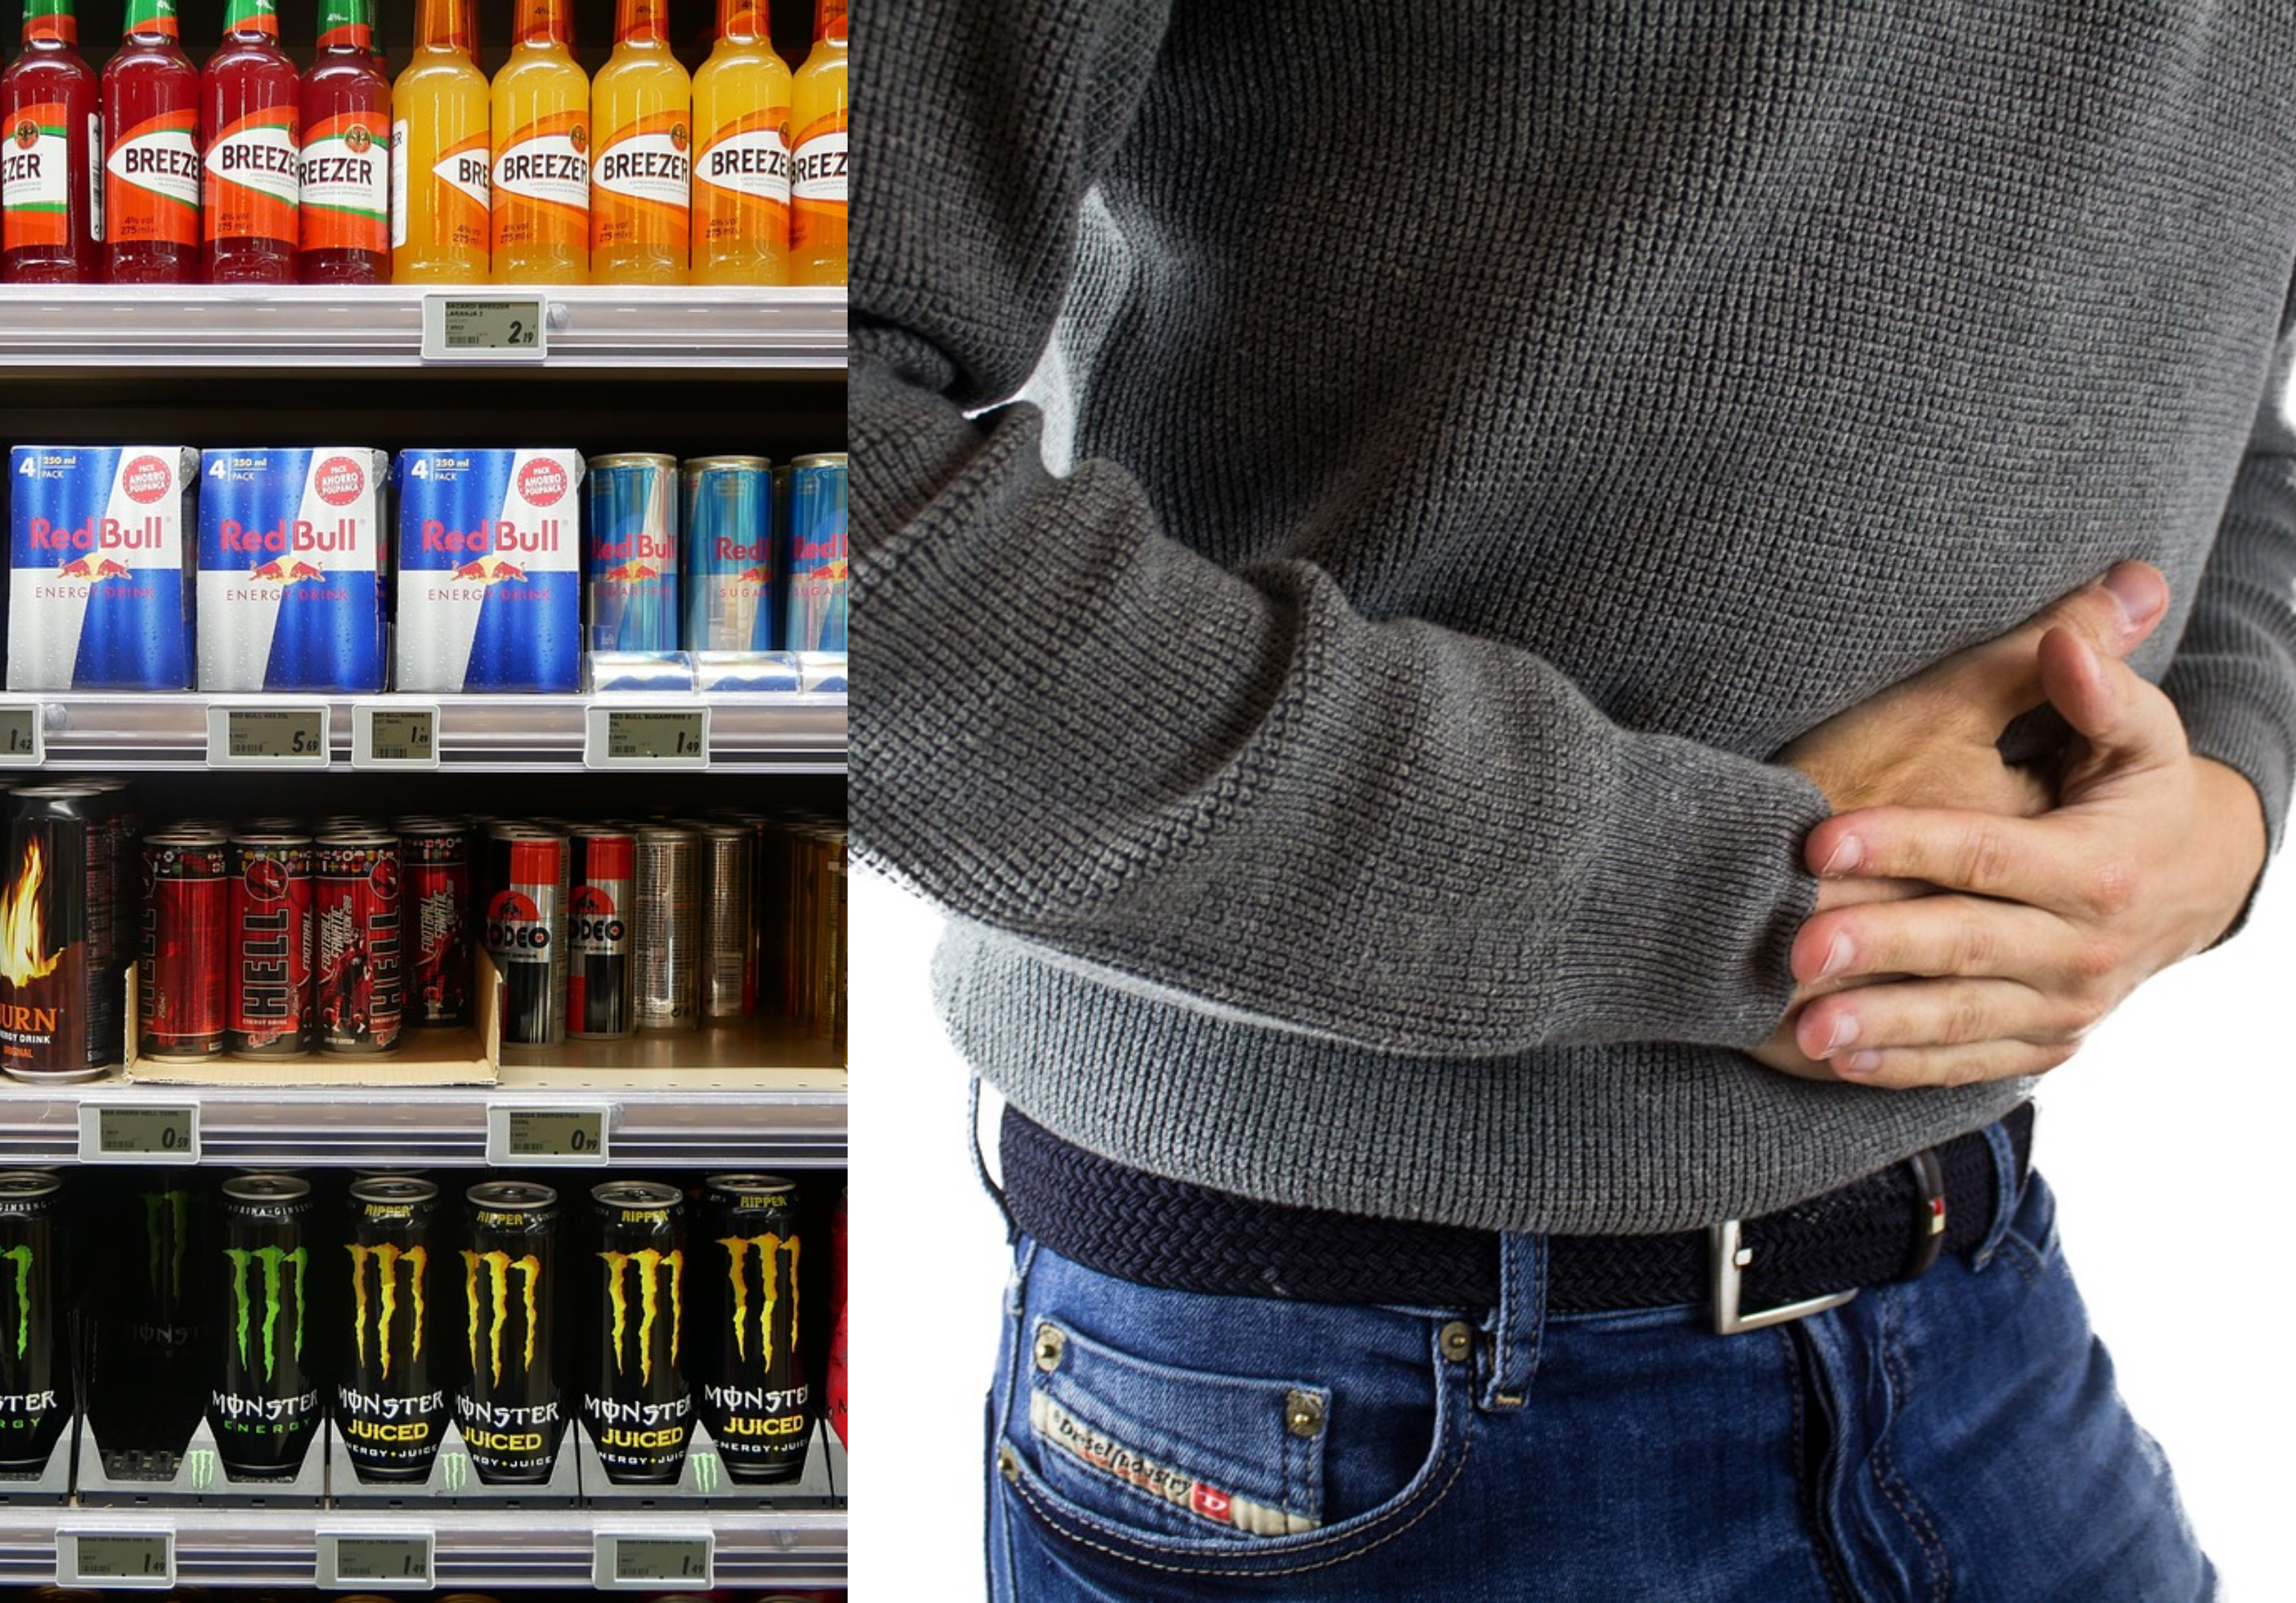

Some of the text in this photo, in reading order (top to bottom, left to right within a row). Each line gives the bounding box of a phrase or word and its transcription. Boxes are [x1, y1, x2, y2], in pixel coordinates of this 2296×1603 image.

[222, 145, 299, 177] BREEZE
[504, 154, 588, 186] BREEZER
[604, 152, 687, 184] BREEZER
[712, 148, 790, 178] BREEZE
[121, 225, 137, 236] 275
[453, 234, 470, 243] 275
[19, 456, 36, 478] 4
[42, 470, 64, 478] PACK
[209, 459, 227, 480] 4
[232, 472, 255, 480] PACK
[411, 459, 428, 480] 4
[434, 473, 457, 481] PACK
[30, 516, 162, 550] Red Bull
[221, 518, 355, 551] Red Bull
[423, 519, 559, 551] Red Bull
[715, 537, 762, 561] Red
[36, 587, 155, 598] ENERGY DRINK
[227, 589, 348, 601] ENERGY DRINK
[428, 589, 551, 601] ENERGY DRINK
[292, 730, 319, 753] 5 69
[687, 741, 700, 753] 49
[243, 908, 288, 1017] HELL
[369, 905, 400, 1017] HELL
[19, 1034, 51, 1045] DRINK
[162, 1127, 175, 1149] 0
[571, 1129, 598, 1151] 0 99
[364, 1203, 411, 1218] RIPPER
[740, 1195, 787, 1208] RIPPER
[477, 1210, 524, 1225] RIPPER
[621, 1209, 669, 1224] RIPPER
[0, 1390, 57, 1412] TER
[212, 1388, 318, 1420] MONSTER
[337, 1383, 444, 1419] MONSTER
[224, 1418, 310, 1434] ENERGY
[347, 1419, 429, 1442] JUICED
[723, 1414, 805, 1436] JUICED
[462, 1425, 543, 1451] JUICED
[601, 1426, 684, 1449] JUICED
